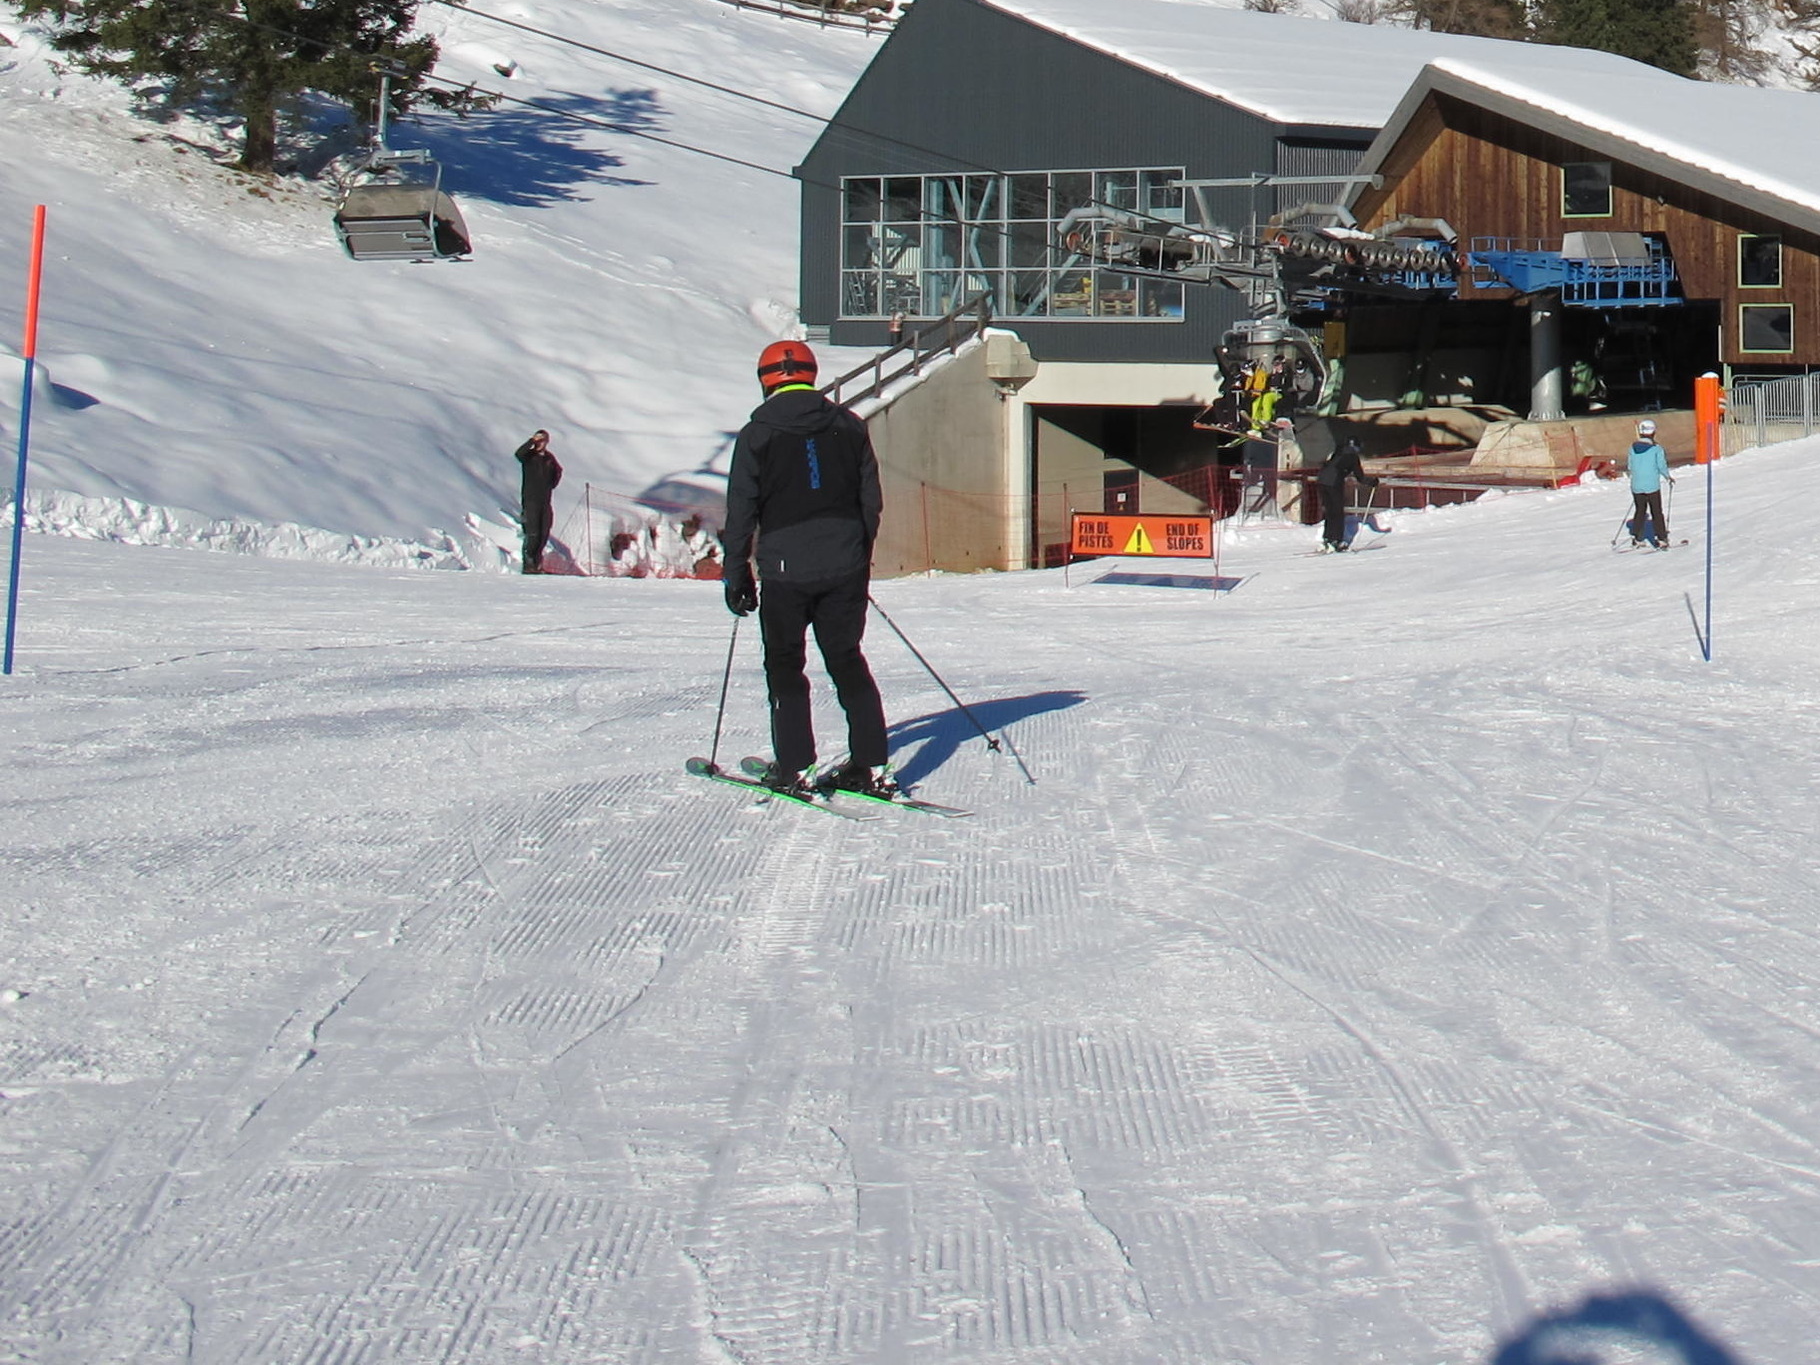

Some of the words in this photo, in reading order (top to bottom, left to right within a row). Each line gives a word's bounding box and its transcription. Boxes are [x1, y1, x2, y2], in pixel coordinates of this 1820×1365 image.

[1078, 521, 1095, 534] FIN
[1096, 521, 1109, 535] DE
[1166, 523, 1184, 536] END
[1187, 523, 1200, 536] OF
[1078, 535, 1114, 549] PISTES
[1167, 537, 1204, 550] SLOPES
